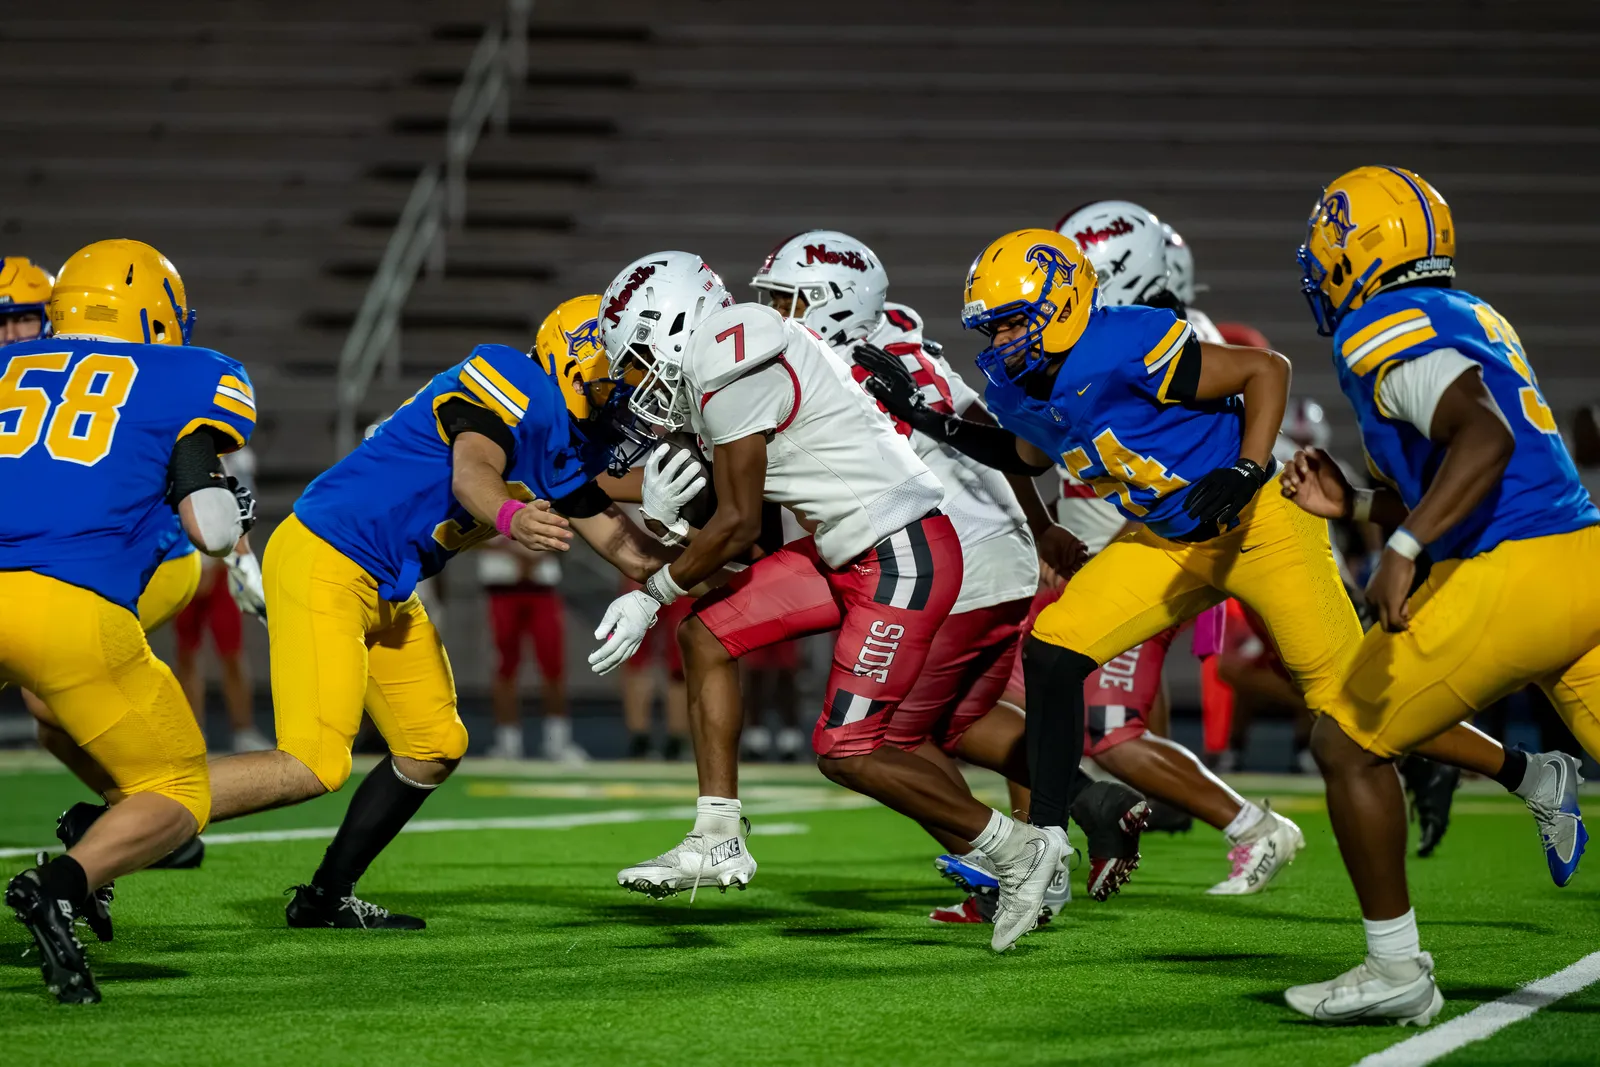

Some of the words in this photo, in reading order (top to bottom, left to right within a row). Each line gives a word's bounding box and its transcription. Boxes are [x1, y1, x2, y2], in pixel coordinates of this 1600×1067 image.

[803, 243, 868, 273] North
[604, 264, 656, 329] North
[715, 322, 745, 364] 7
[0, 351, 140, 467] 58
[1060, 427, 1192, 518] 54
[853, 619, 905, 684] SIDE
[1099, 643, 1144, 693] DE
[710, 836, 741, 867] NIKE
